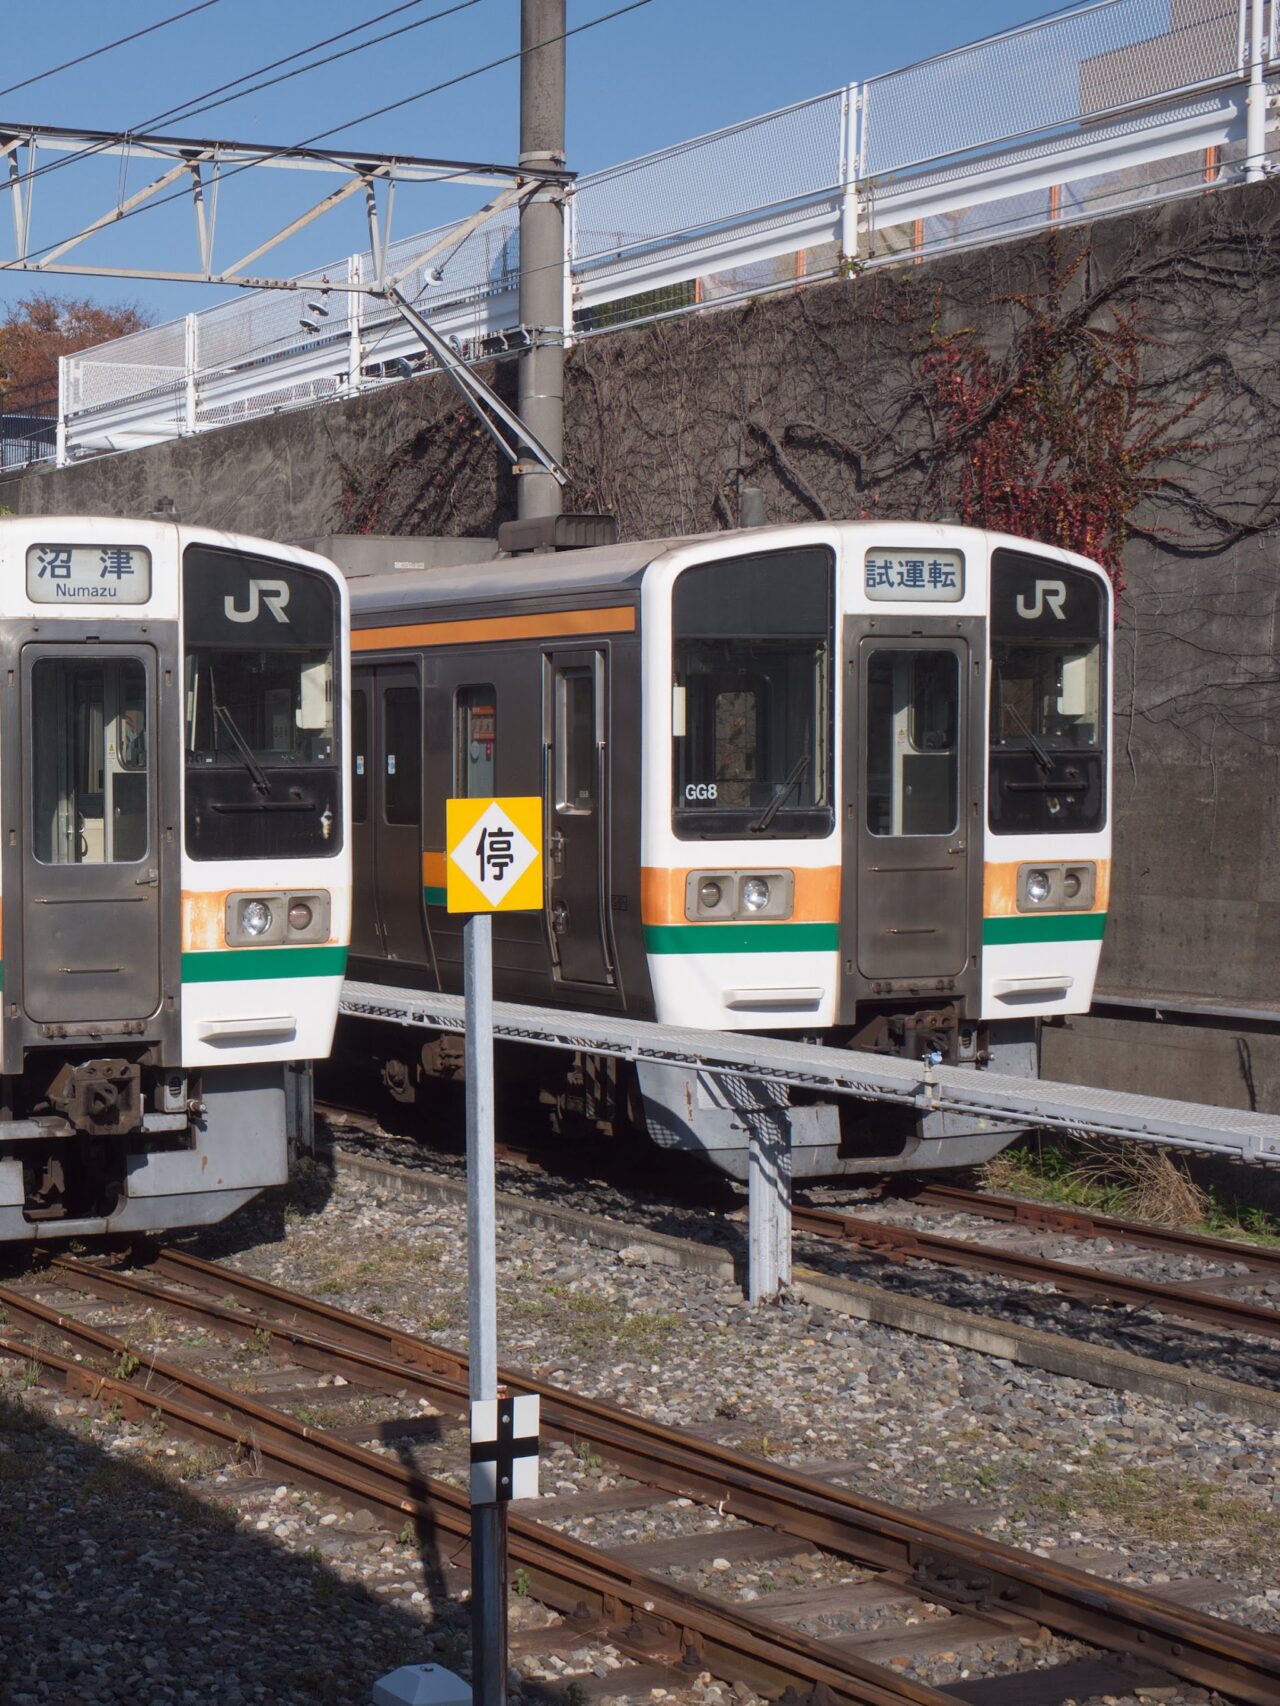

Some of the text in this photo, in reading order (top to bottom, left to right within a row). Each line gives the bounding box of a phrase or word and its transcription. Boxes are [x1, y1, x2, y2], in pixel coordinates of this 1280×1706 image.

[36, 547, 135, 580] 沼津
[865, 559, 957, 589] 試運転
[55, 583, 117, 597] Numazu
[224, 579, 290, 623] JR
[1016, 579, 1067, 620] JR
[685, 783, 718, 800] GG8
[475, 826, 514, 882] 停
